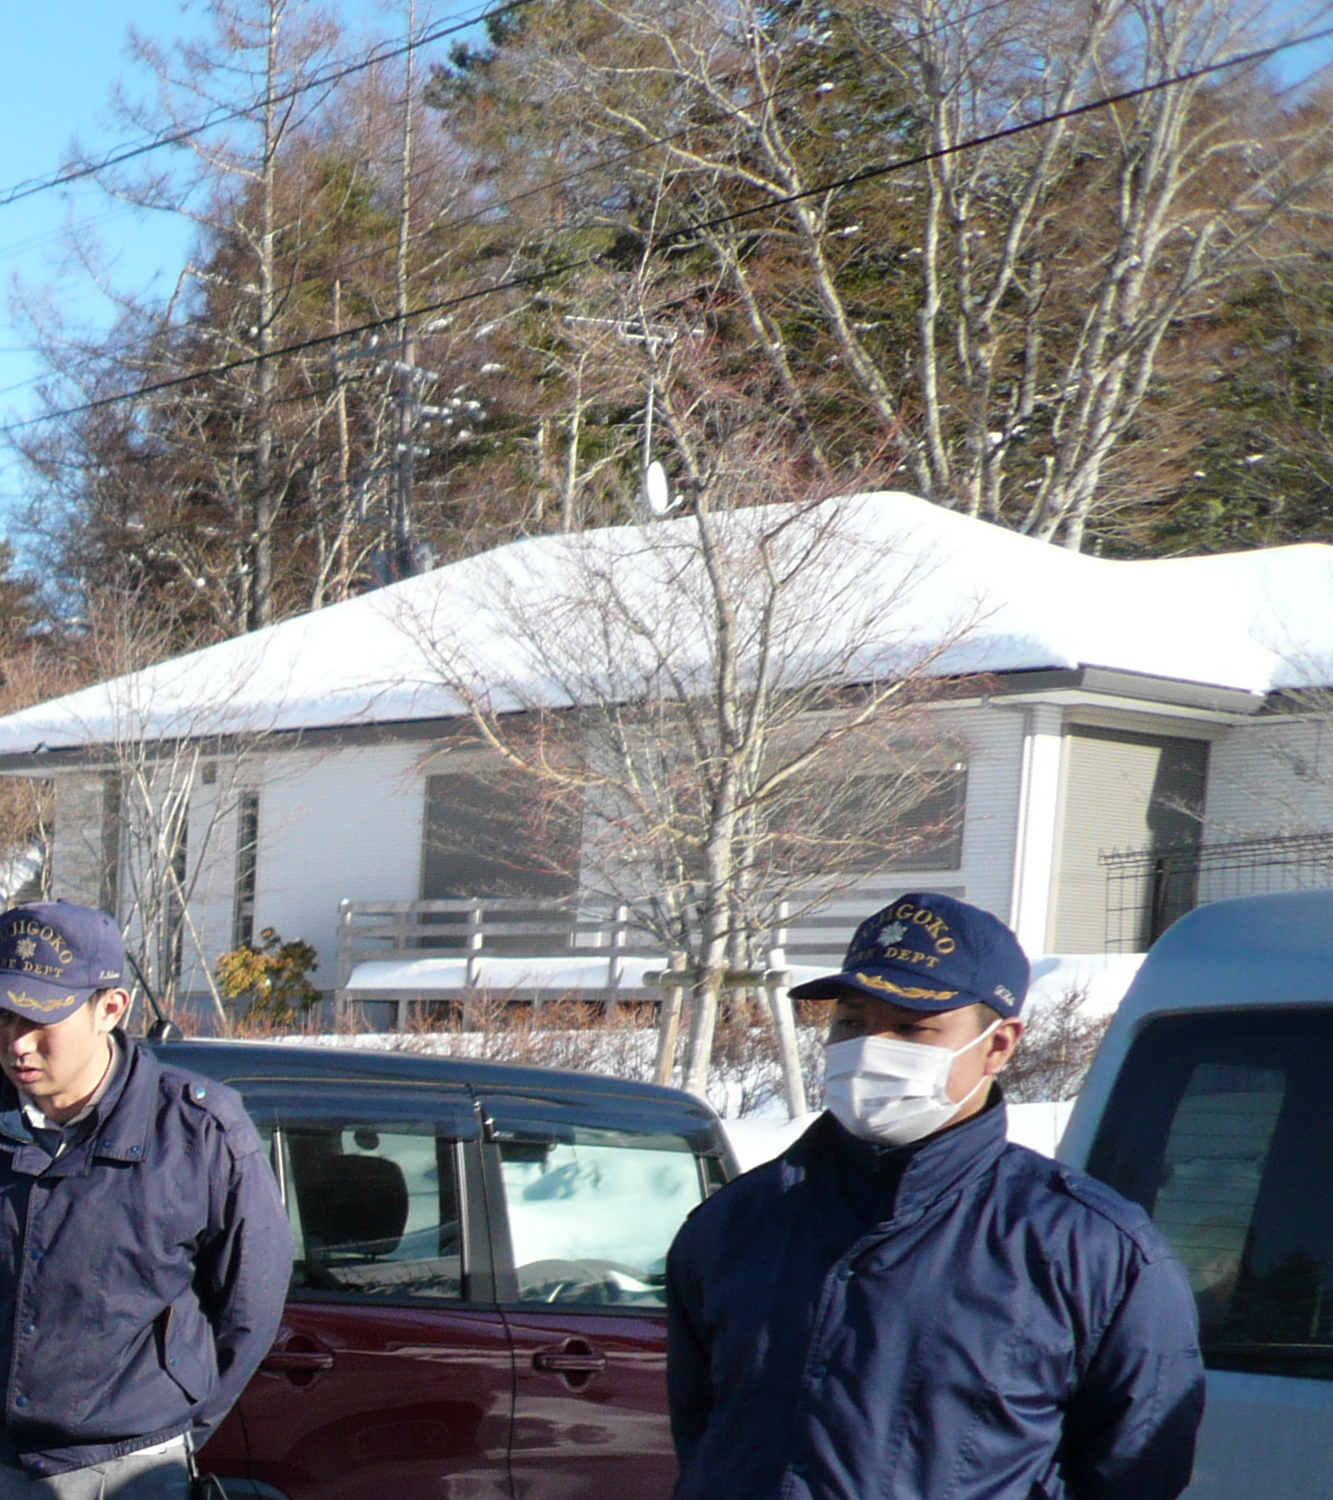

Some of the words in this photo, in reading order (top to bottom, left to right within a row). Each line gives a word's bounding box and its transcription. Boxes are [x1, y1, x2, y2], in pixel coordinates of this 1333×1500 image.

[851, 903, 956, 954] JIGOKO
[23, 960, 64, 978] DEPT
[884, 946, 940, 969] DEPT
